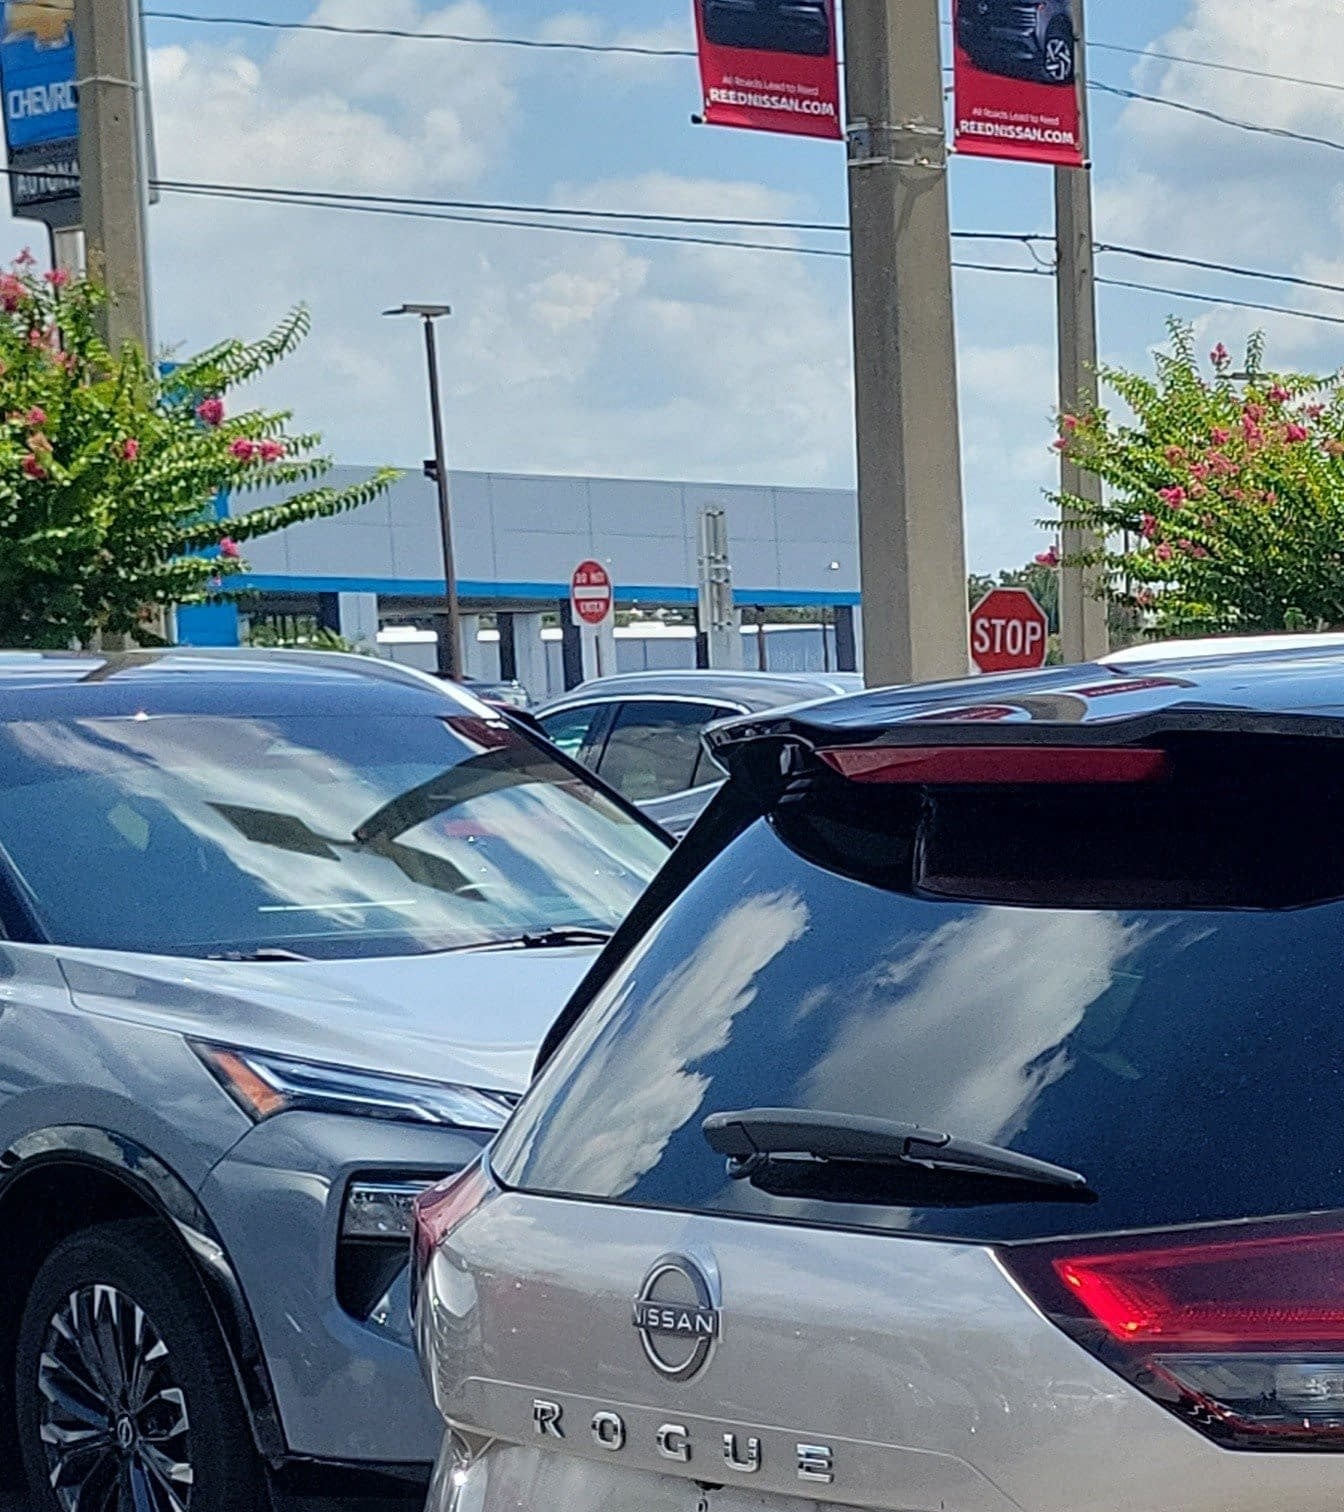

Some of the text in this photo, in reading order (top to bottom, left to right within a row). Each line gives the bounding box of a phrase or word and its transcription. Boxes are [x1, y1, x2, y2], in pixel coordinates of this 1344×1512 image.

[709, 88, 834, 116] REEDNISSAN.COM
[960, 119, 1074, 145] REEDNISSAN.COM
[974, 618, 1042, 656] STOP
[533, 1398, 834, 1484] ROGUE
